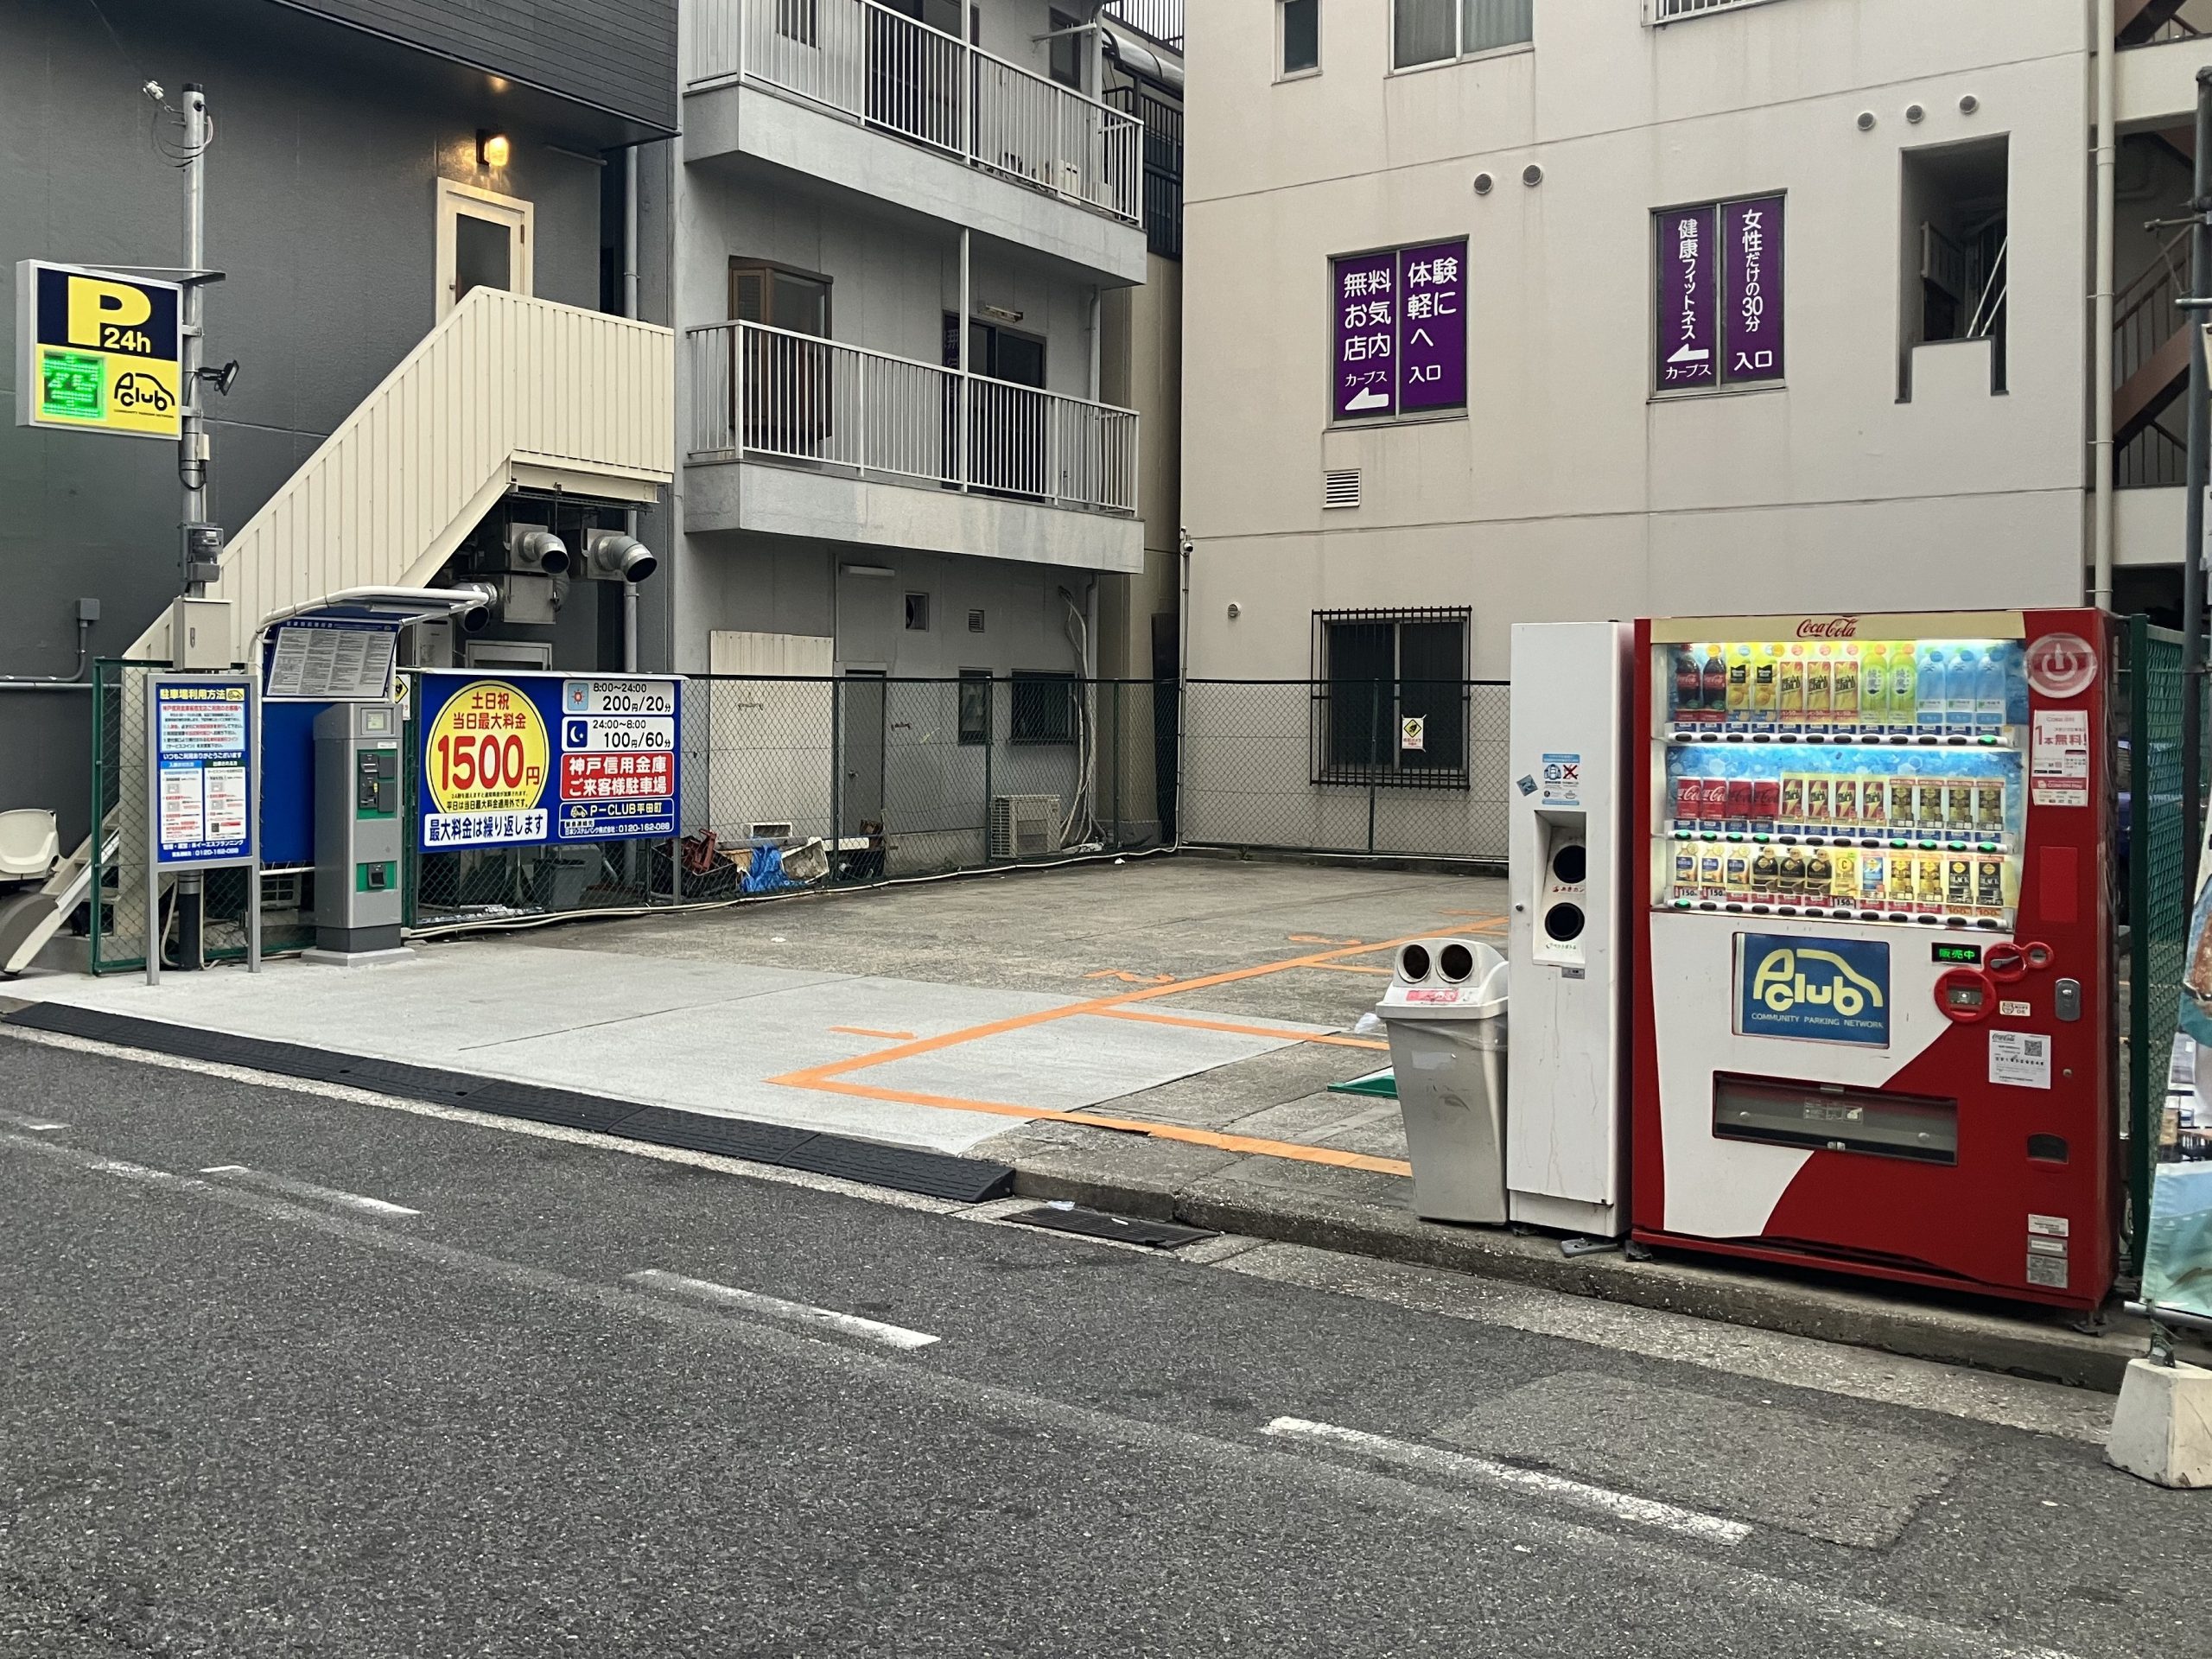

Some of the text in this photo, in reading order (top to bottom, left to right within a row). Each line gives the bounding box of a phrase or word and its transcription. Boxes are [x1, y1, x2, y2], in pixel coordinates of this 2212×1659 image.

[1678, 218, 1699, 340] 健康フィットネス
[1741, 208, 1764, 332] 女性だけの30分
[67, 276, 151, 346] P
[104, 327, 151, 353] 24h
[1733, 350, 1772, 371] 入口
[1344, 371, 1388, 387] カーブス
[1408, 365, 1441, 384] 入口
[1665, 364, 1712, 380] カーブス
[1796, 617, 1859, 638] Coca-Cola
[472, 692, 510, 711] 土日祝
[453, 713, 526, 730] 当日最大料金
[569, 755, 667, 774] 神戸信用金庫
[569, 778, 667, 797] ご来客様駐車場
[429, 814, 543, 842] 最大料金は繰り返します
[1751, 1012, 1884, 1029] COMMUNITY PARKING NETWORK
